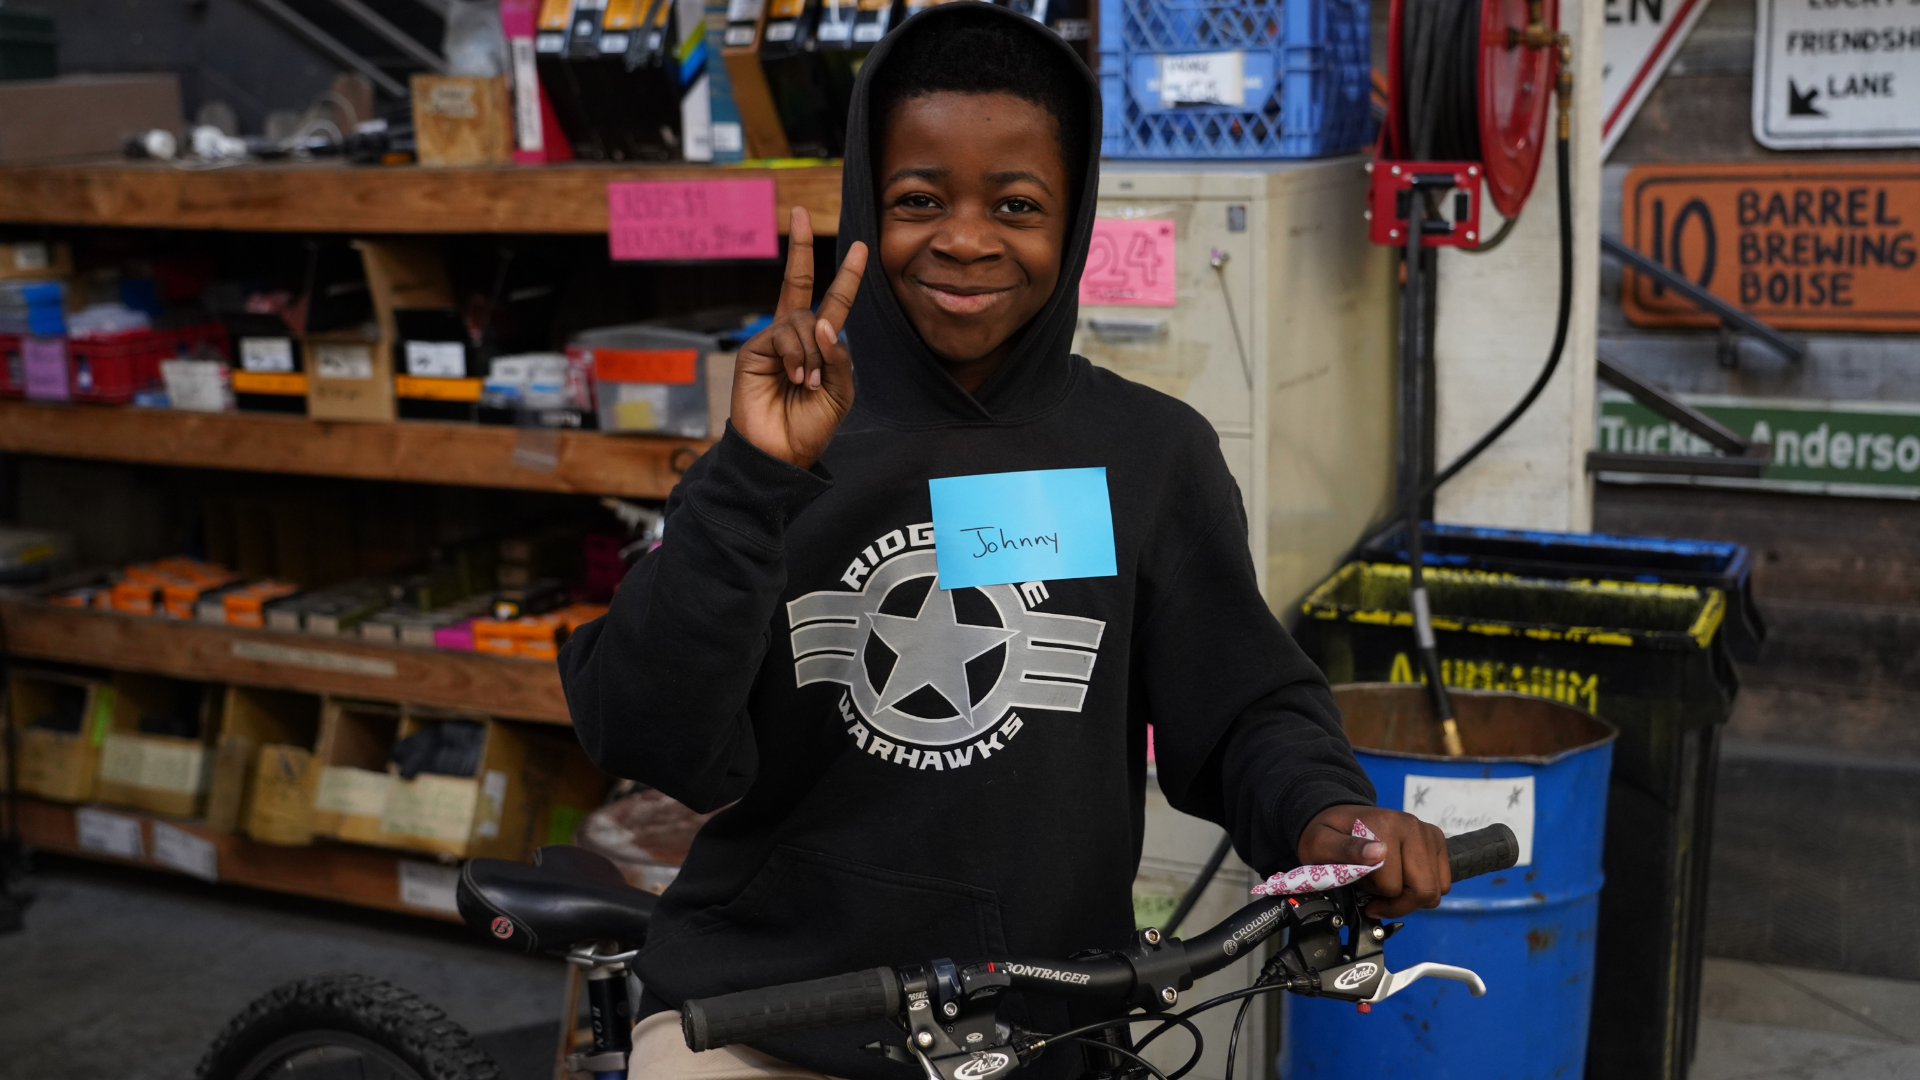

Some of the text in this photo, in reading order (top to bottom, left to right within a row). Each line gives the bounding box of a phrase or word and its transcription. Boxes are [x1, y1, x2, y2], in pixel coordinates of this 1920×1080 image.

[1828, 73, 1895, 98] LANE
[1738, 188, 1901, 227] BARREL
[1652, 198, 1716, 297] 10
[1739, 232, 1917, 270] BREWING
[1740, 272, 1853, 306] BOISE
[960, 526, 1058, 559] Johnny
[838, 689, 1024, 771] WARHAWKS
[1341, 965, 1374, 986] Avid
[964, 1056, 1004, 1077] Avid
